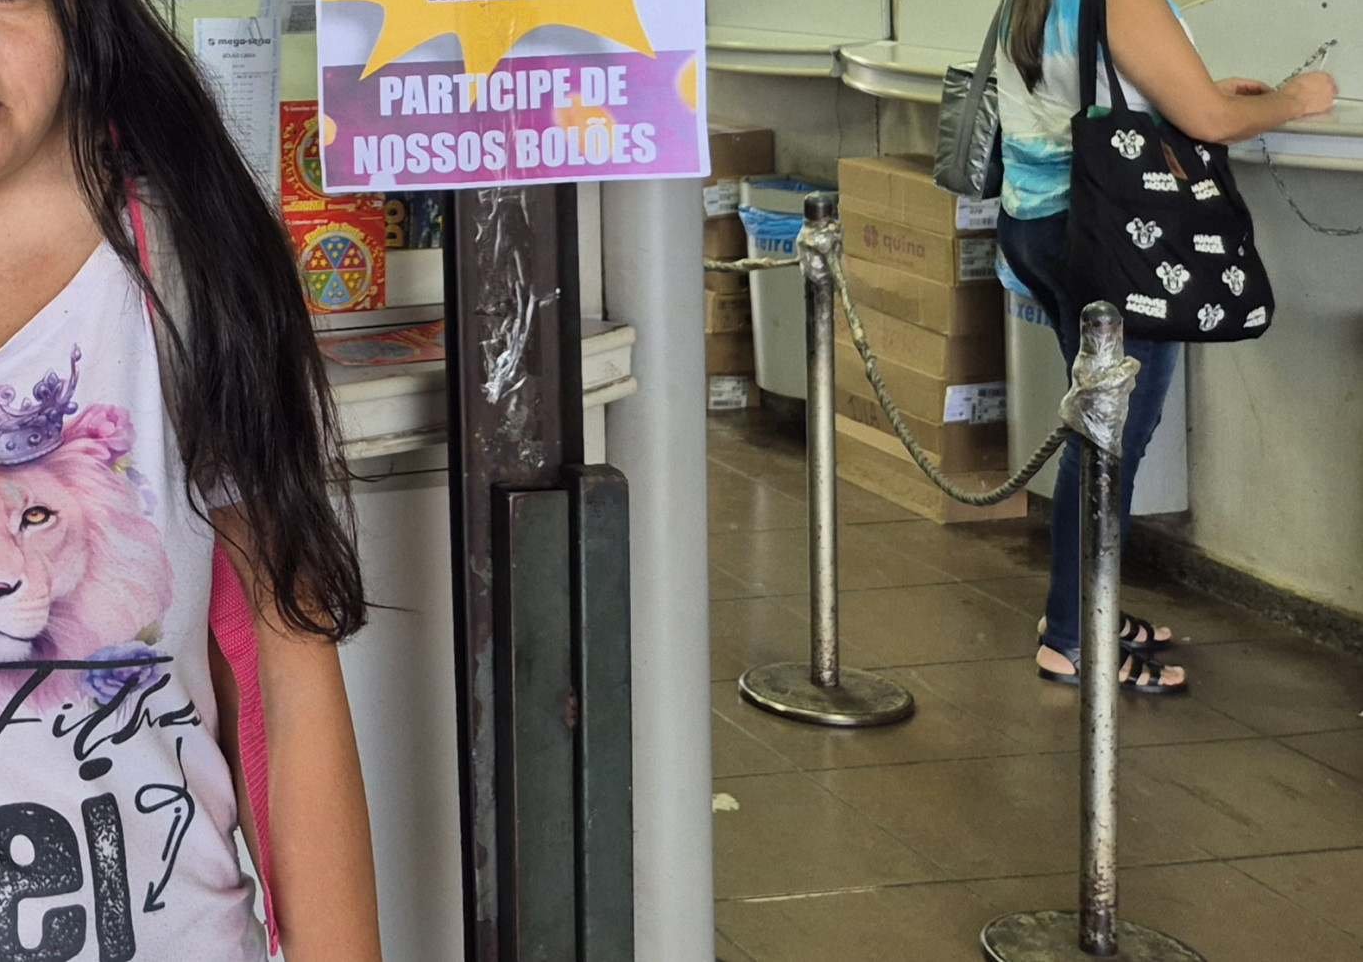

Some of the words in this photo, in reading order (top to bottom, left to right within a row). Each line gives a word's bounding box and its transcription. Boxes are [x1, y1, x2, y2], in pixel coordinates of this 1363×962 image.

[379, 69, 572, 116] PARTICIPE
[580, 66, 628, 107] DE
[354, 128, 507, 175] NOSSOS
[515, 117, 657, 169] BOLÕES
[883, 232, 926, 258] quina
